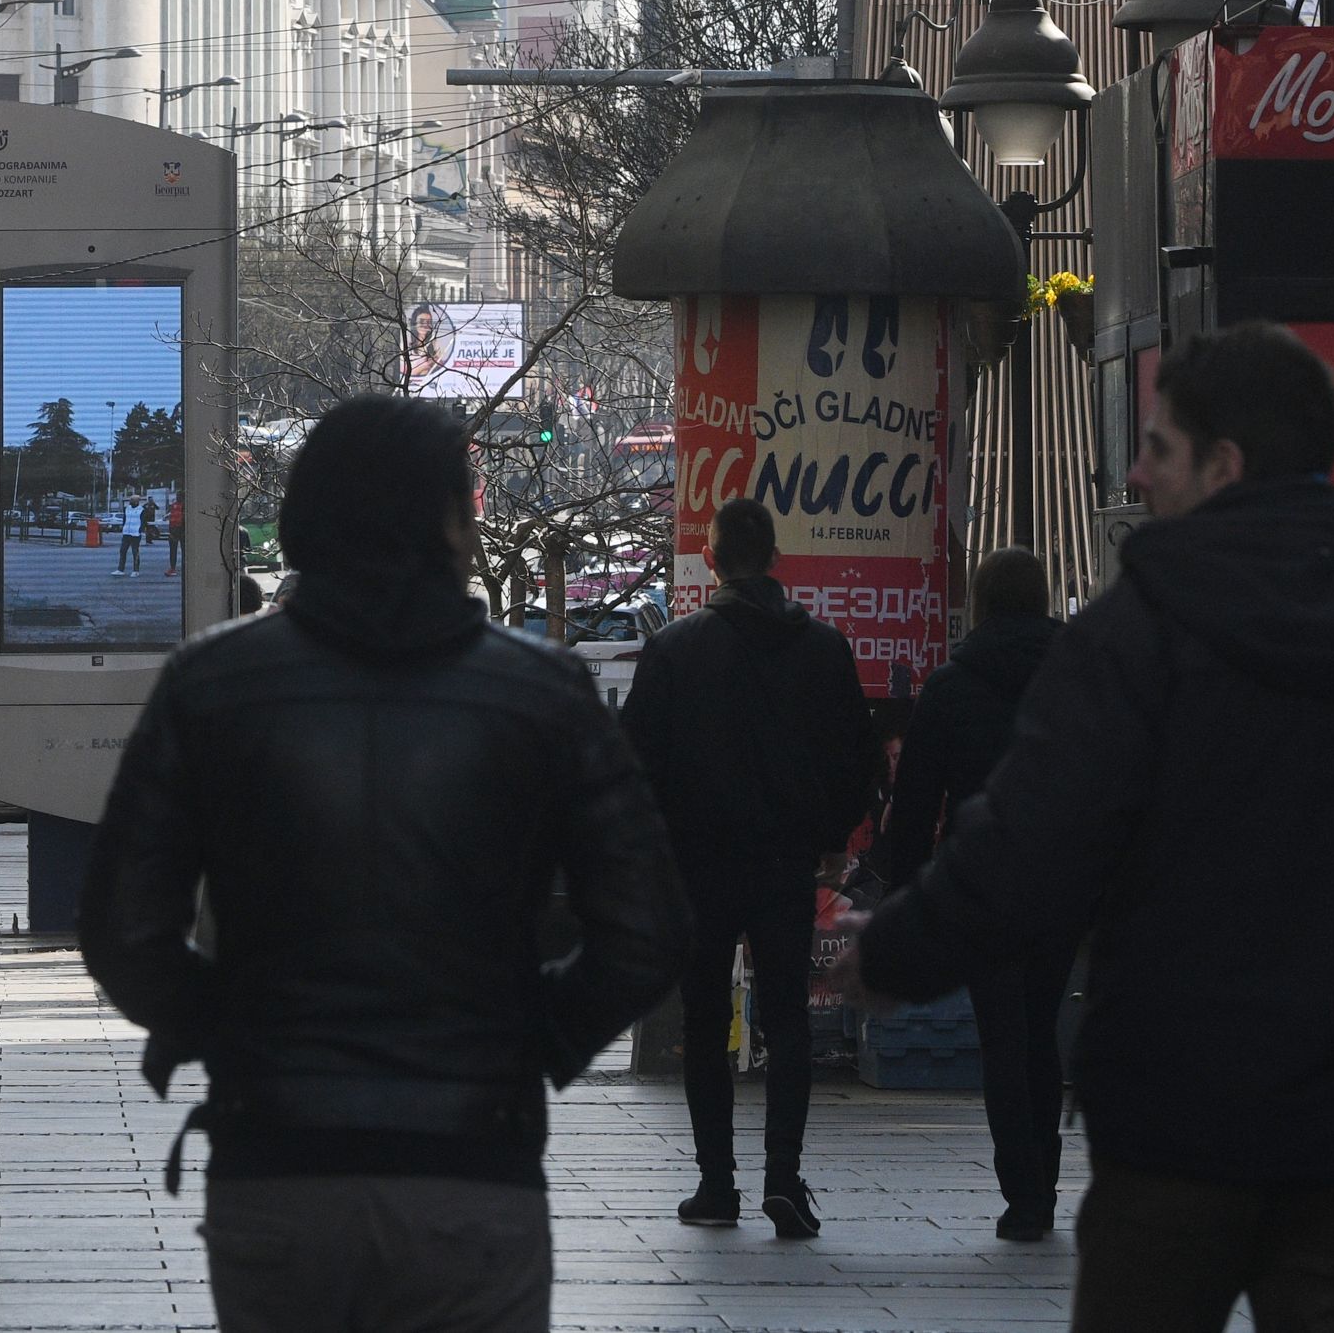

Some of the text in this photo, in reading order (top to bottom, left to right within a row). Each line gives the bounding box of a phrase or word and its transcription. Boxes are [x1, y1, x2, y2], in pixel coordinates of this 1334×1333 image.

[3, 175, 58, 185] KOMPANIJE
[154, 183, 191, 197] Београд
[815, 390, 936, 442] GLADNE
[810, 526, 890, 541] 14.FEBRUAR
[785, 586, 926, 623] ВЕЗДА
